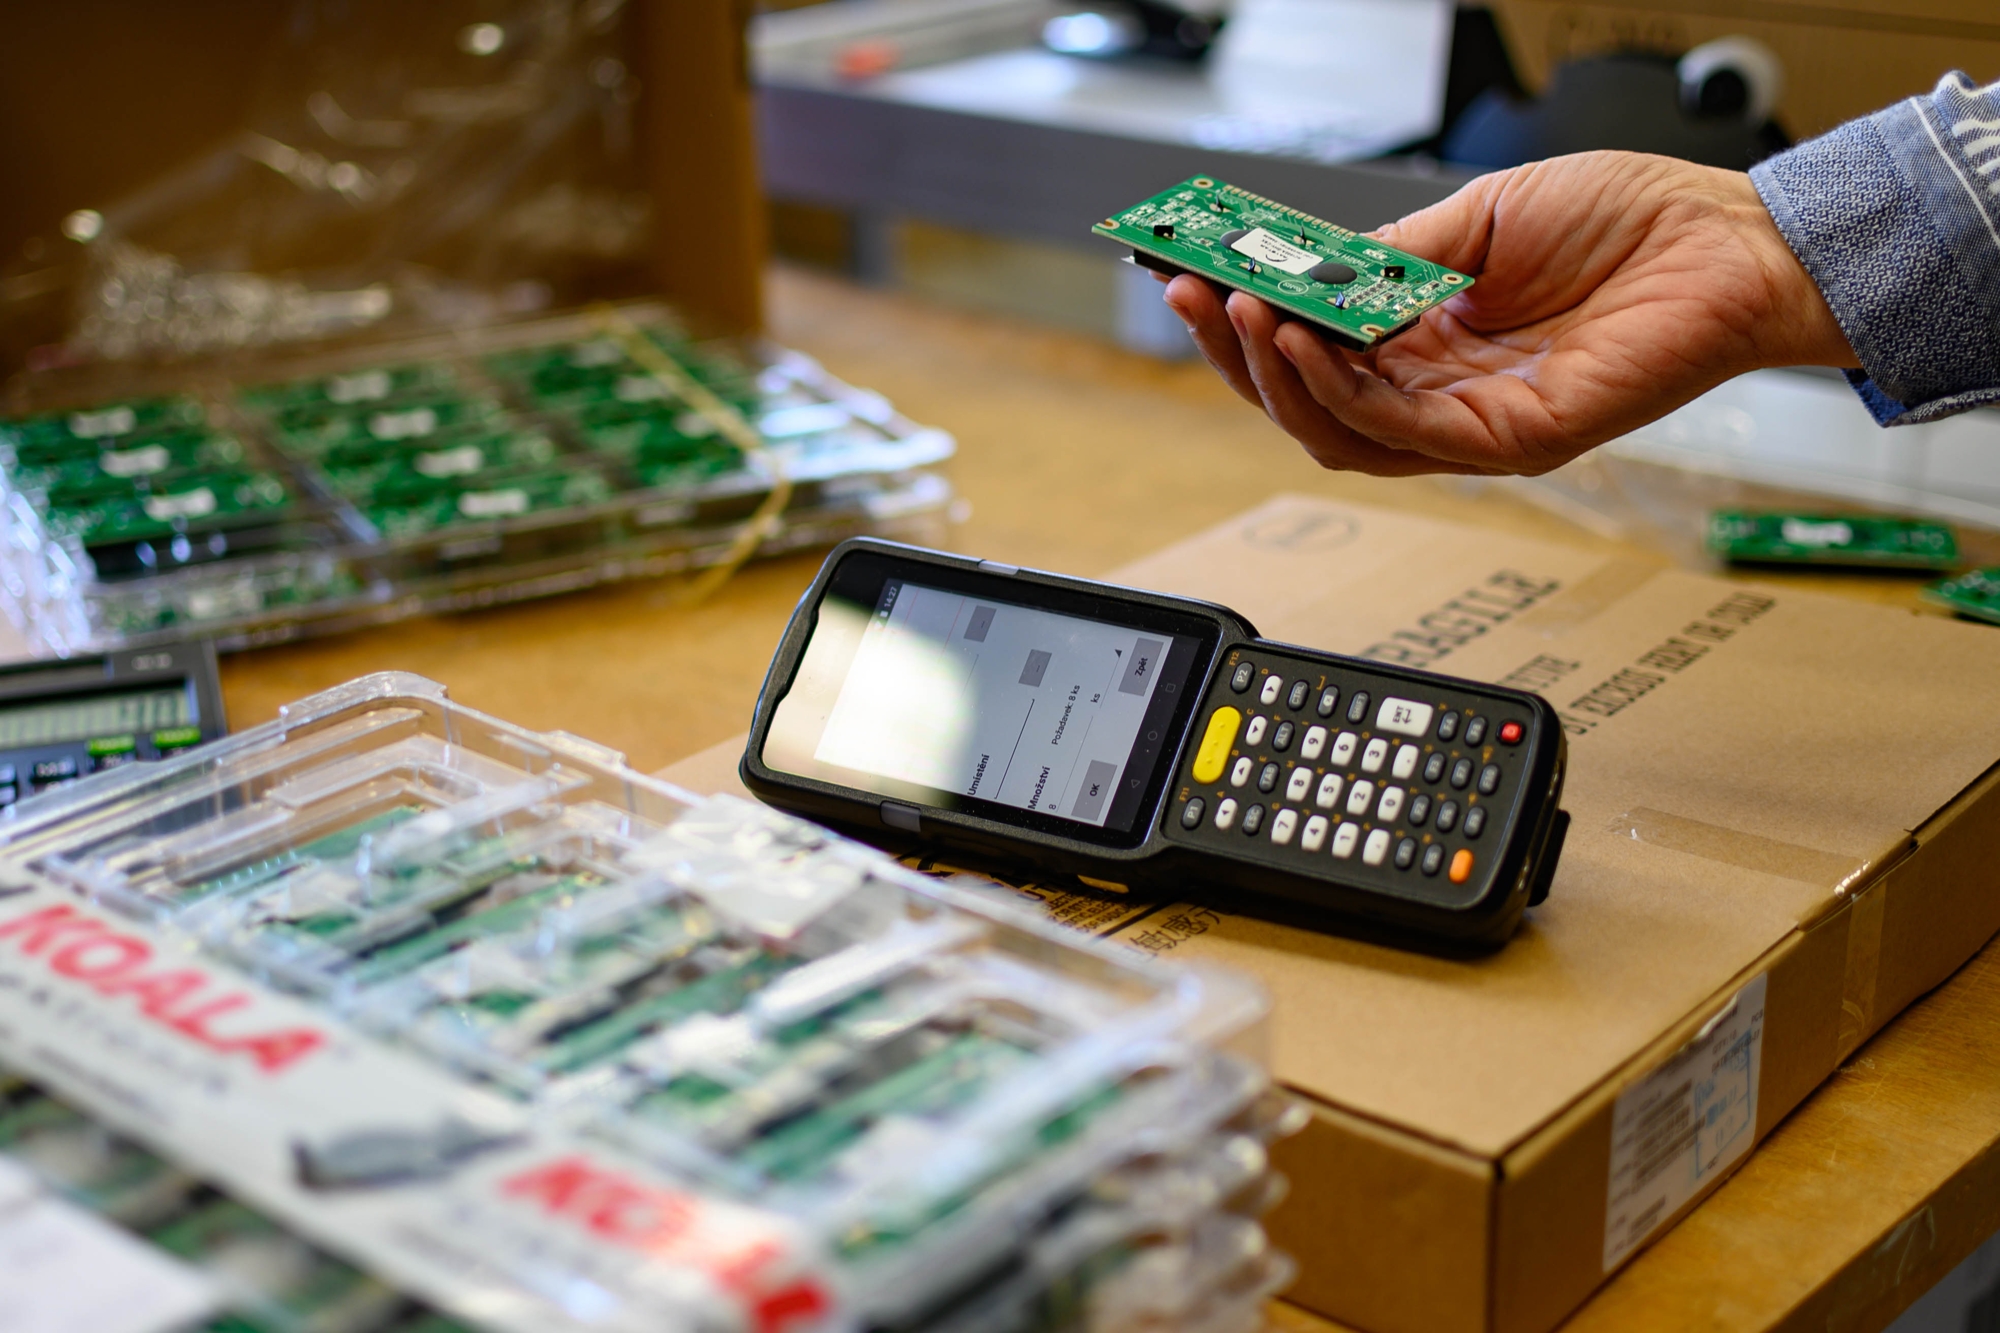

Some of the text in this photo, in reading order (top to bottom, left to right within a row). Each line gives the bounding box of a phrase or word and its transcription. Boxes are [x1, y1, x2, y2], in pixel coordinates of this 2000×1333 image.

[883, 586, 898, 608] 14:27
[1360, 568, 1560, 669] RAGILE
[1229, 651, 1240, 666] F12
[1134, 656, 1149, 677] Zpět
[1237, 669, 1248, 683] P2
[1090, 692, 1101, 704] ks
[1291, 685, 1304, 705] CTRL
[1352, 695, 1366, 719] SHIFT
[1392, 705, 1404, 723] ENT
[1051, 684, 1081, 746] Požadavek: 8 ks
[1278, 727, 1290, 745] ALT
[1308, 737, 1319, 745] 9
[1338, 744, 1349, 752] 6
[1368, 749, 1380, 758] 3
[967, 753, 990, 796] Umístění
[1262, 766, 1276, 785] TAB
[1027, 765, 1051, 810] Množství
[1089, 783, 1101, 797] OK
[1293, 778, 1305, 788] 8
[1323, 785, 1335, 794] 5
[1179, 787, 1190, 801] F11
[1354, 792, 1366, 801] 2
[1048, 803, 1057, 811] 8
[1384, 798, 1396, 808] 0
[1187, 805, 1199, 820] P1
[1247, 808, 1260, 827] ESC
[1277, 820, 1289, 829] 7
[1308, 827, 1320, 836] 4
[0, 905, 326, 1074] KOALA
